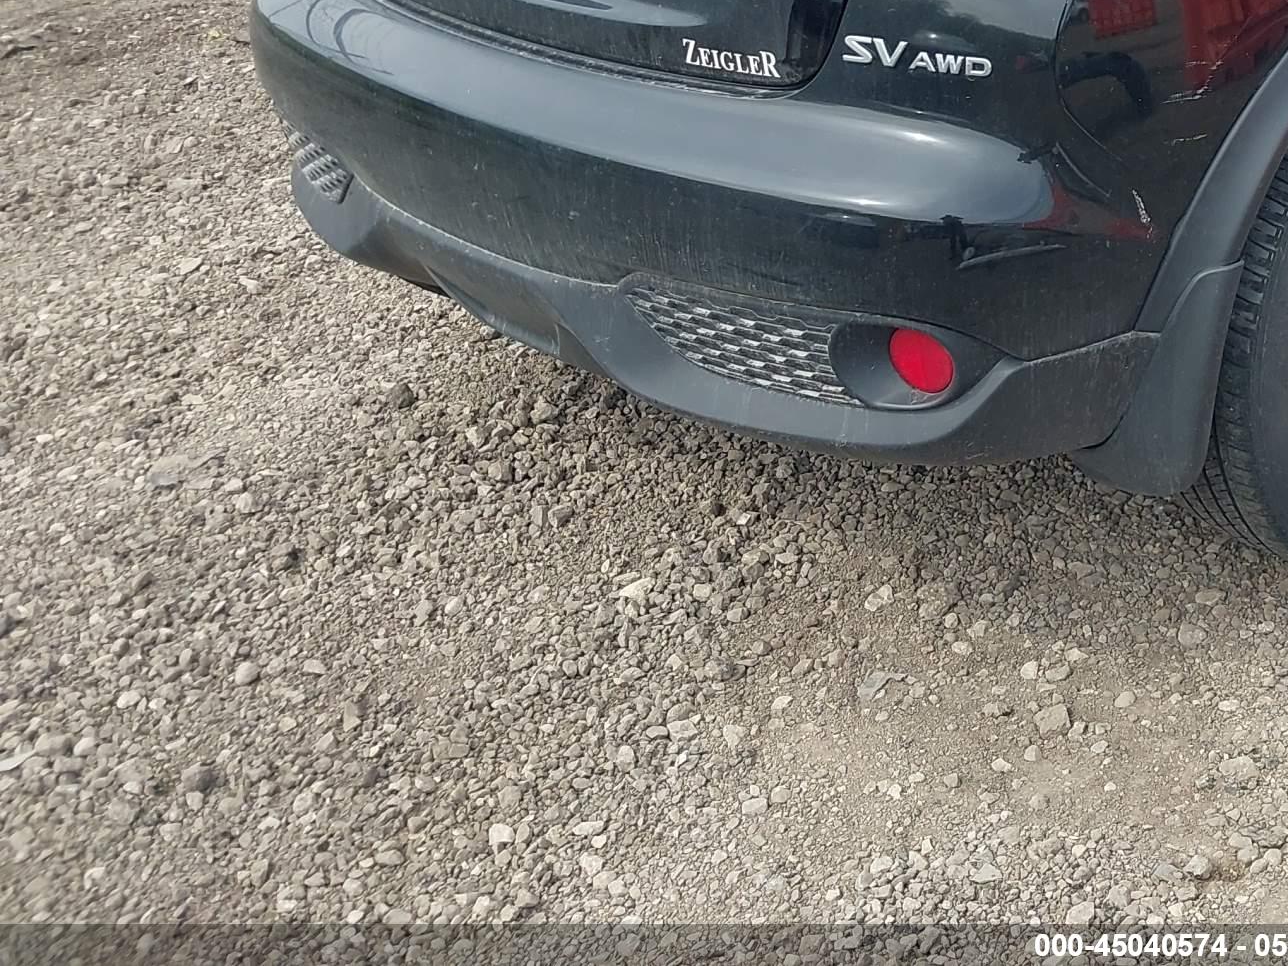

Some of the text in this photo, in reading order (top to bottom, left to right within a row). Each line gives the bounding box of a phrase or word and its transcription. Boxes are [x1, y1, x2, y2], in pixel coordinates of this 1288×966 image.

[682, 38, 781, 79] ZEIGLER
[842, 35, 992, 77] SV AWD
